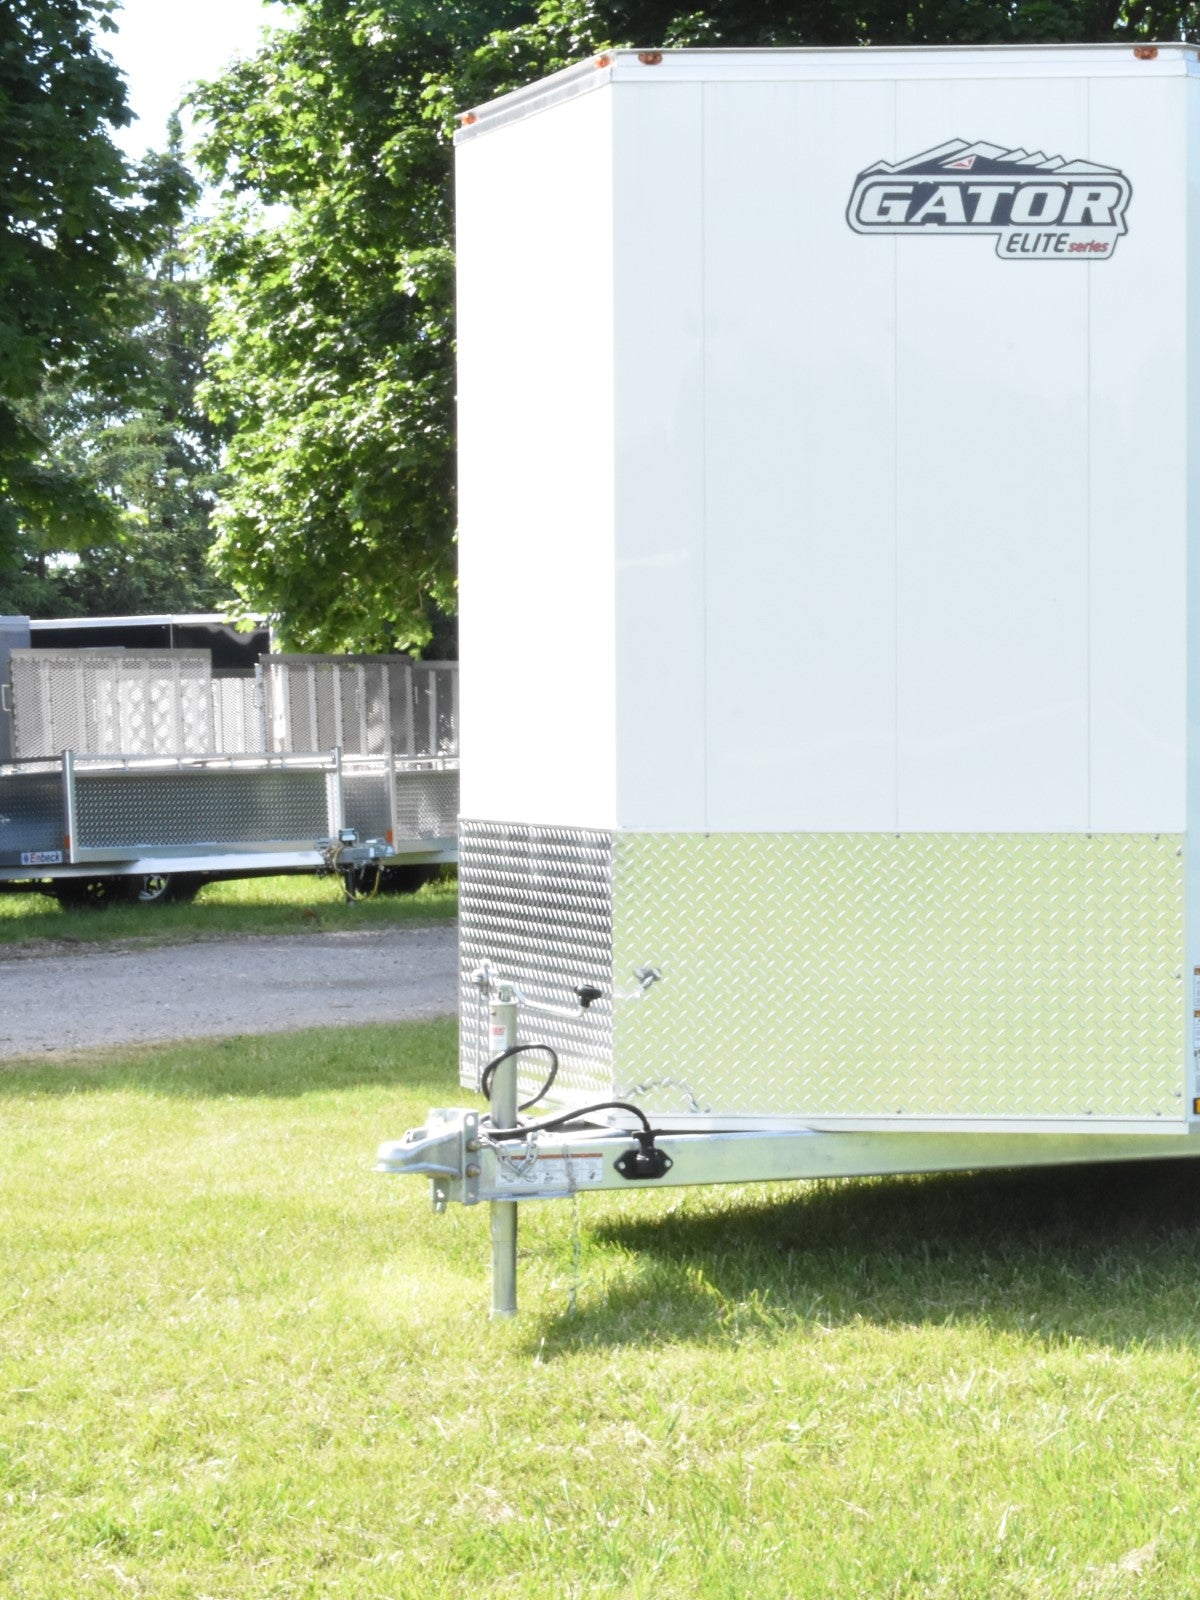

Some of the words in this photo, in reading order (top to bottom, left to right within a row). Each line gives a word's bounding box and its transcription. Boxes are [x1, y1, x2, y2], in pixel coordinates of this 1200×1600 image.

[857, 183, 1121, 226] GATOR
[1005, 232, 1070, 253] ELITE
[1067, 240, 1110, 253] series
